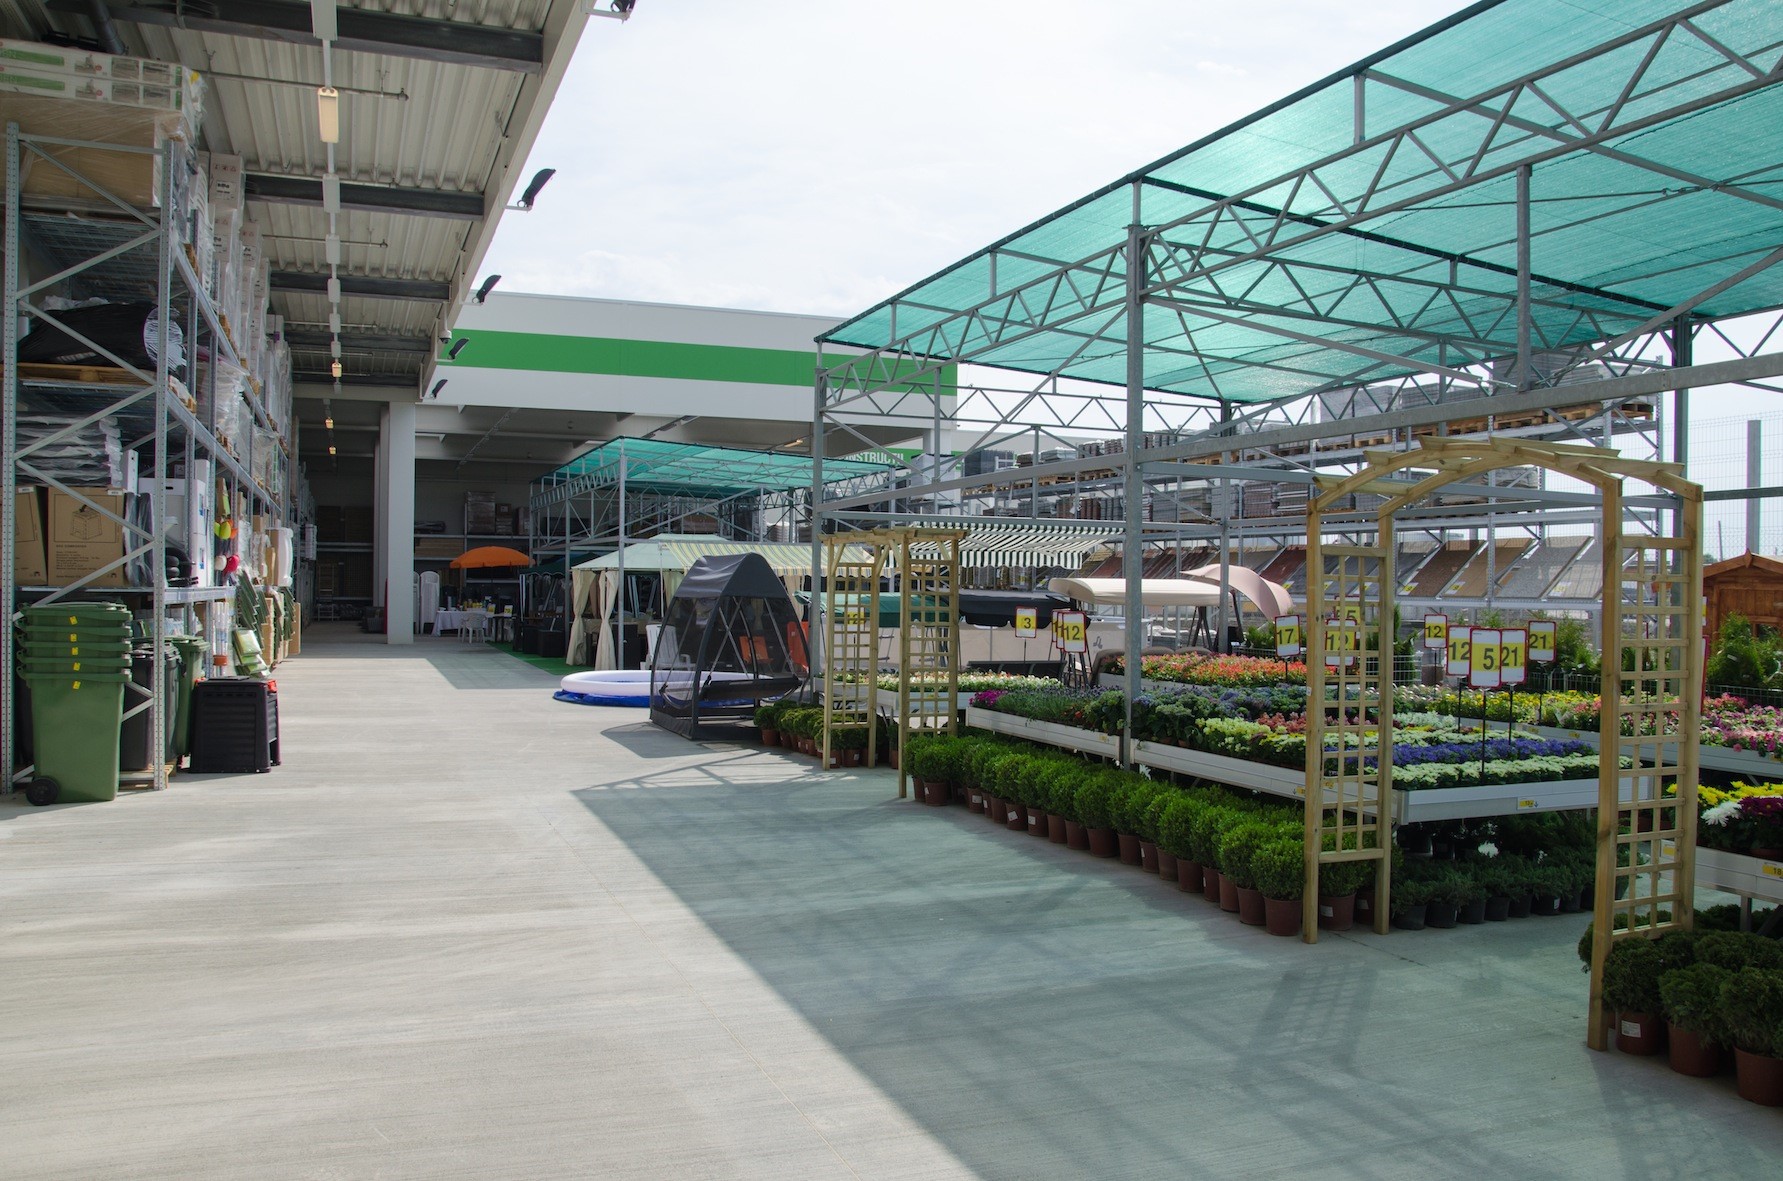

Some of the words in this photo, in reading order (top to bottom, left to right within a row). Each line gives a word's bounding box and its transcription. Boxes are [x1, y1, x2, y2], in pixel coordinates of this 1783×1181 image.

[1024, 617, 1032, 629] 3
[1064, 625, 1080, 641] 12
[1276, 628, 1294, 645] 17
[1425, 625, 1442, 638] 12
[1529, 633, 1547, 649] 21
[1449, 641, 1470, 661] 12
[1483, 647, 1495, 670] 5
[1501, 646, 1518, 667] 21
